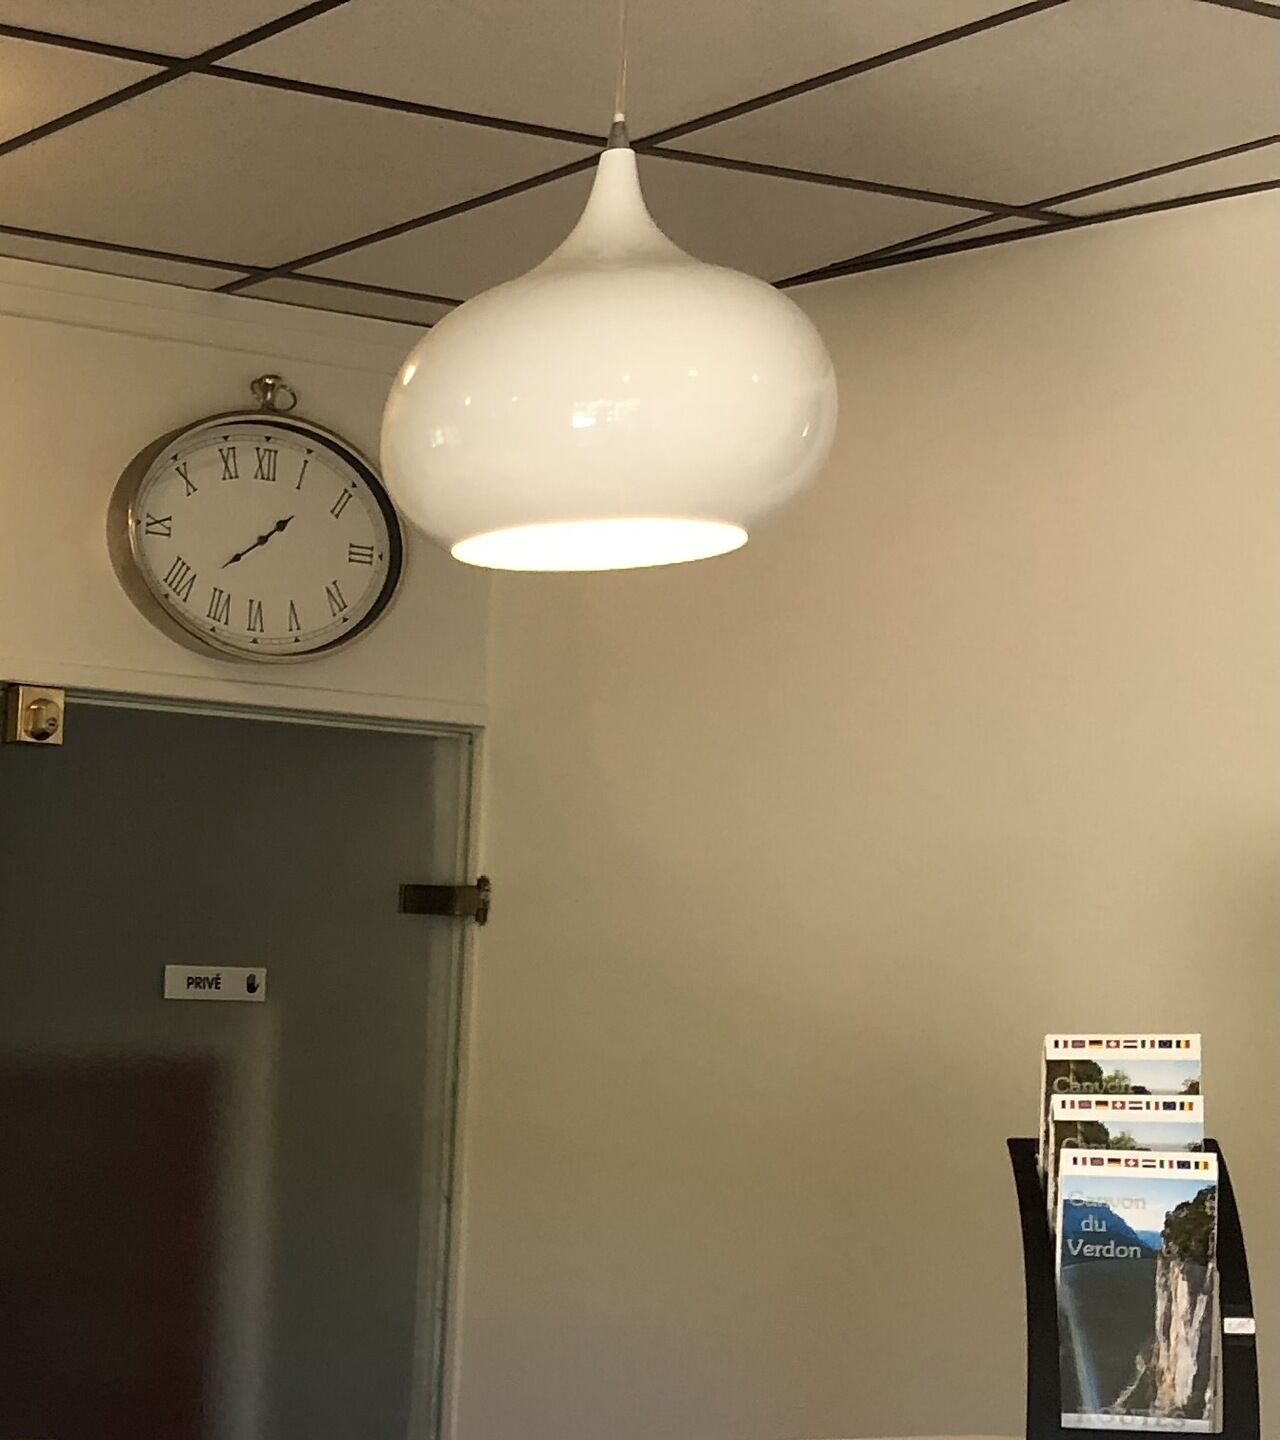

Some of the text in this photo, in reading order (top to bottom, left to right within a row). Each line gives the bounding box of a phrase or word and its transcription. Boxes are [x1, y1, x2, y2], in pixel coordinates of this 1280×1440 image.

[175, 462, 198, 496] X
[218, 447, 239, 480] XI
[254, 447, 278, 482] XII
[296, 459, 308, 490] I
[330, 489, 352, 519] II
[145, 513, 172, 538] IX
[349, 543, 374, 565] III
[163, 556, 197, 602] VIII
[206, 587, 231, 625] VII
[325, 580, 348, 616] IV
[247, 599, 264, 632] VI
[288, 600, 301, 631] V
[186, 973, 222, 990] PRIVÉ
[1069, 1190, 1146, 1211] Canyon
[1080, 1214, 1107, 1233] du
[1066, 1238, 1142, 1259] Verdon
